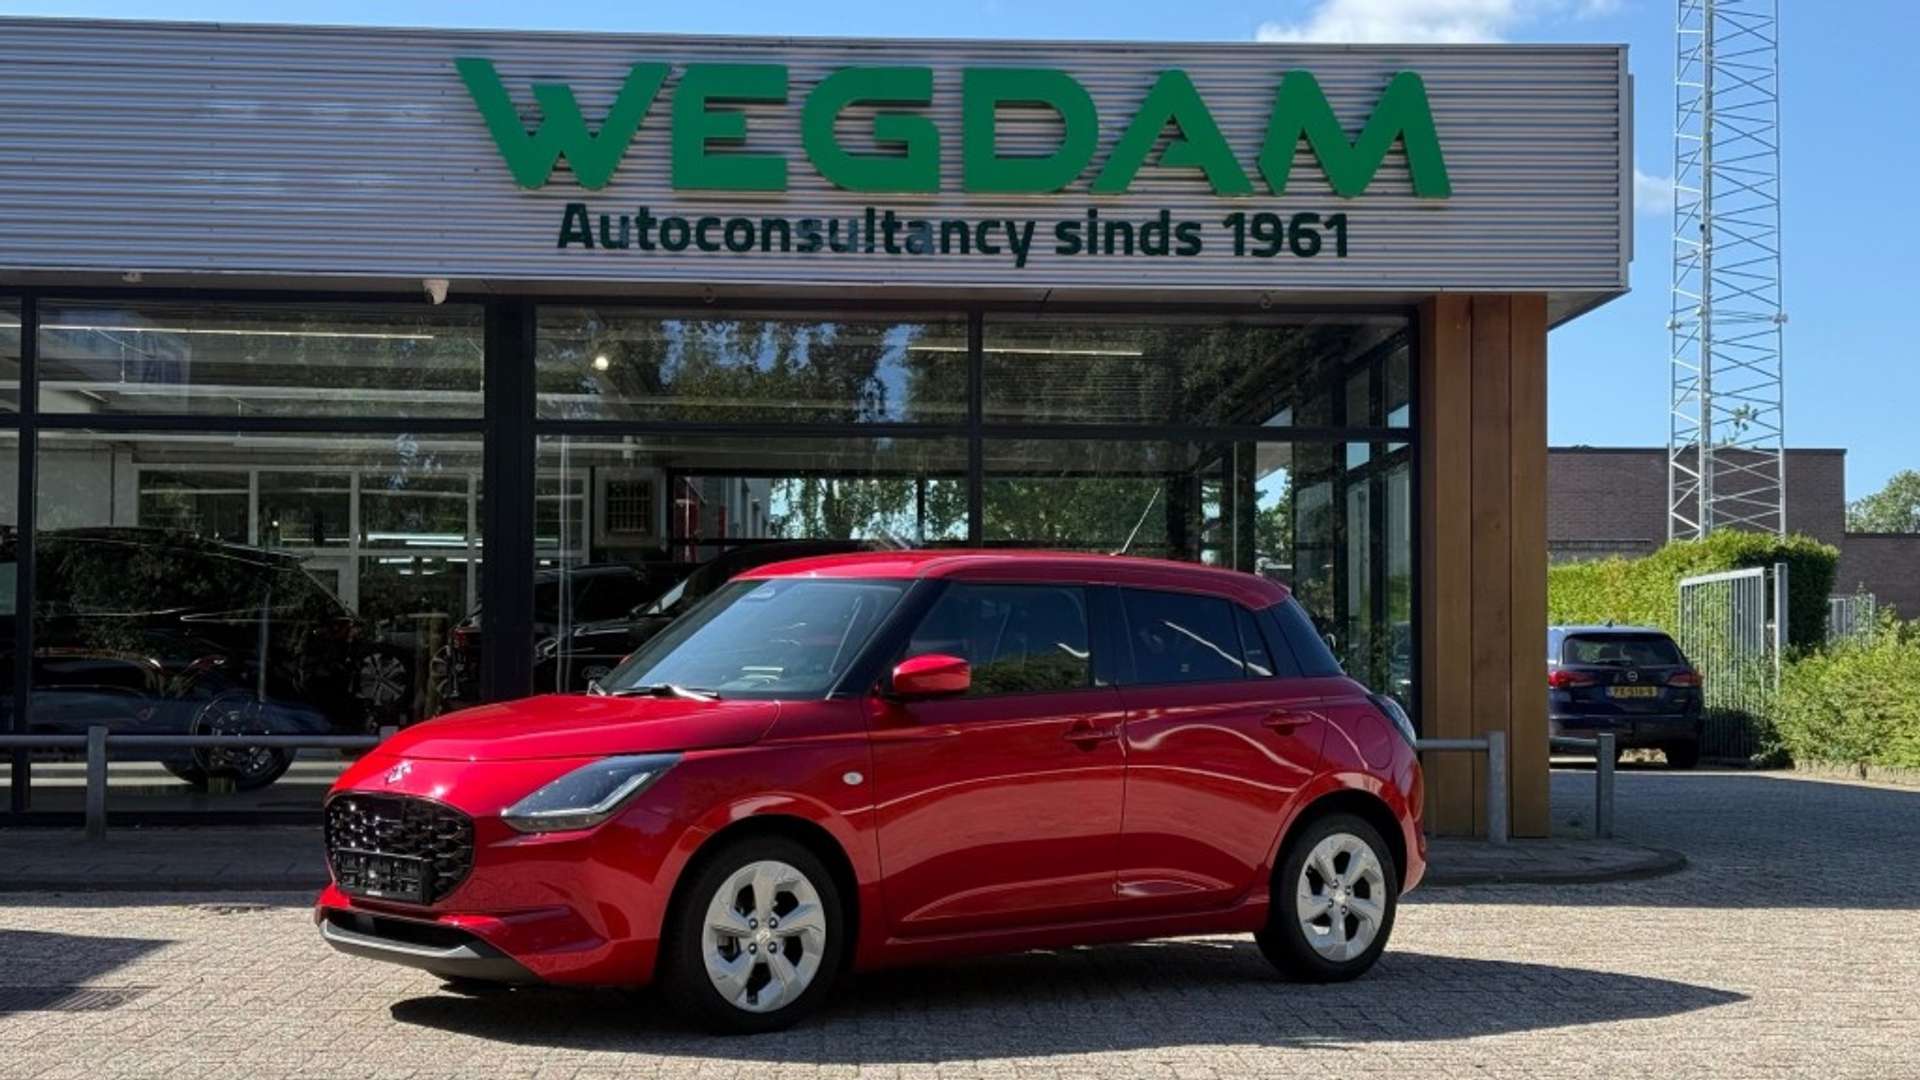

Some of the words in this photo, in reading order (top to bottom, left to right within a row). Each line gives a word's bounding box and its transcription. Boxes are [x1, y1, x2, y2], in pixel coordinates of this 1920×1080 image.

[455, 58, 1452, 198] WEGDAM
[557, 203, 1036, 268] Autoconsultancy
[1055, 208, 1202, 256] sinds
[1222, 213, 1348, 257] 1961
